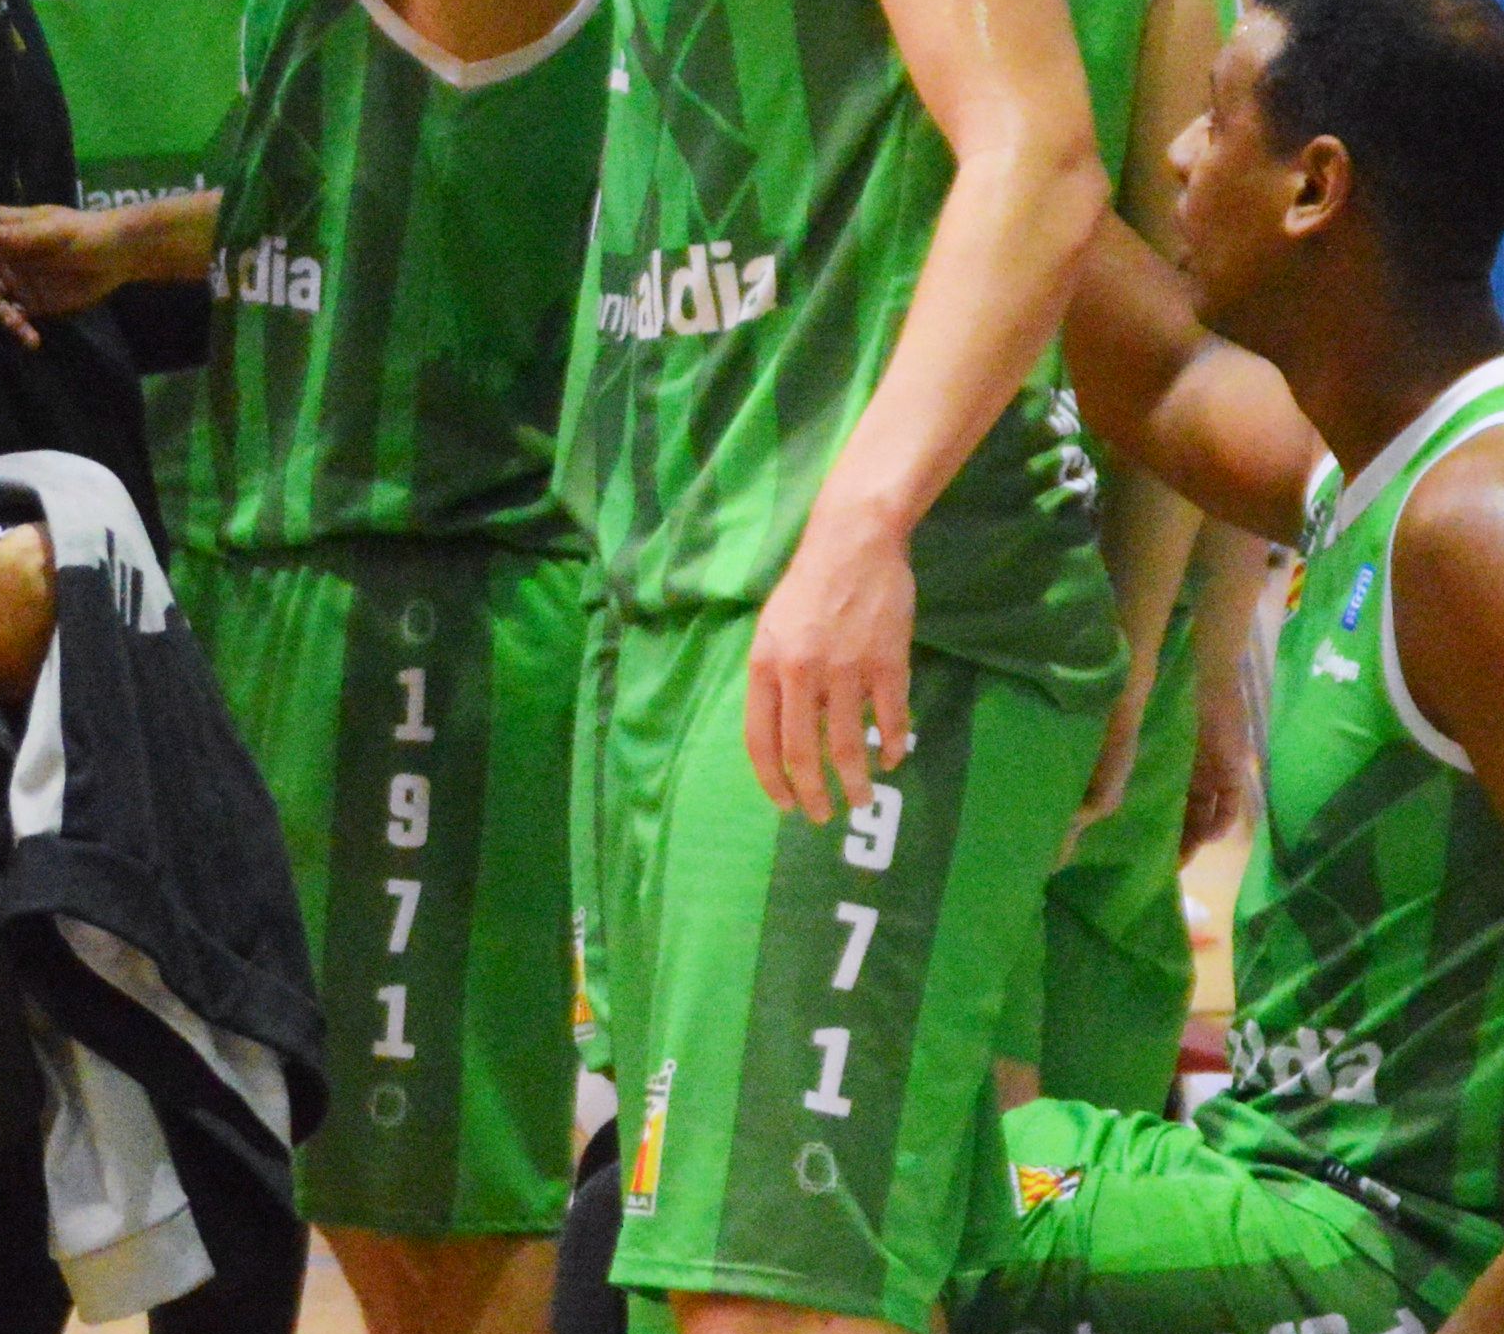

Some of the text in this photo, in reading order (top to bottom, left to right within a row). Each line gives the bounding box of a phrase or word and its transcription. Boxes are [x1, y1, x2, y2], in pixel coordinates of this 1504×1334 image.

[238, 235, 323, 313] dia
[669, 239, 778, 337] dia
[371, 667, 433, 1061] 1971
[802, 728, 918, 1118] 971
